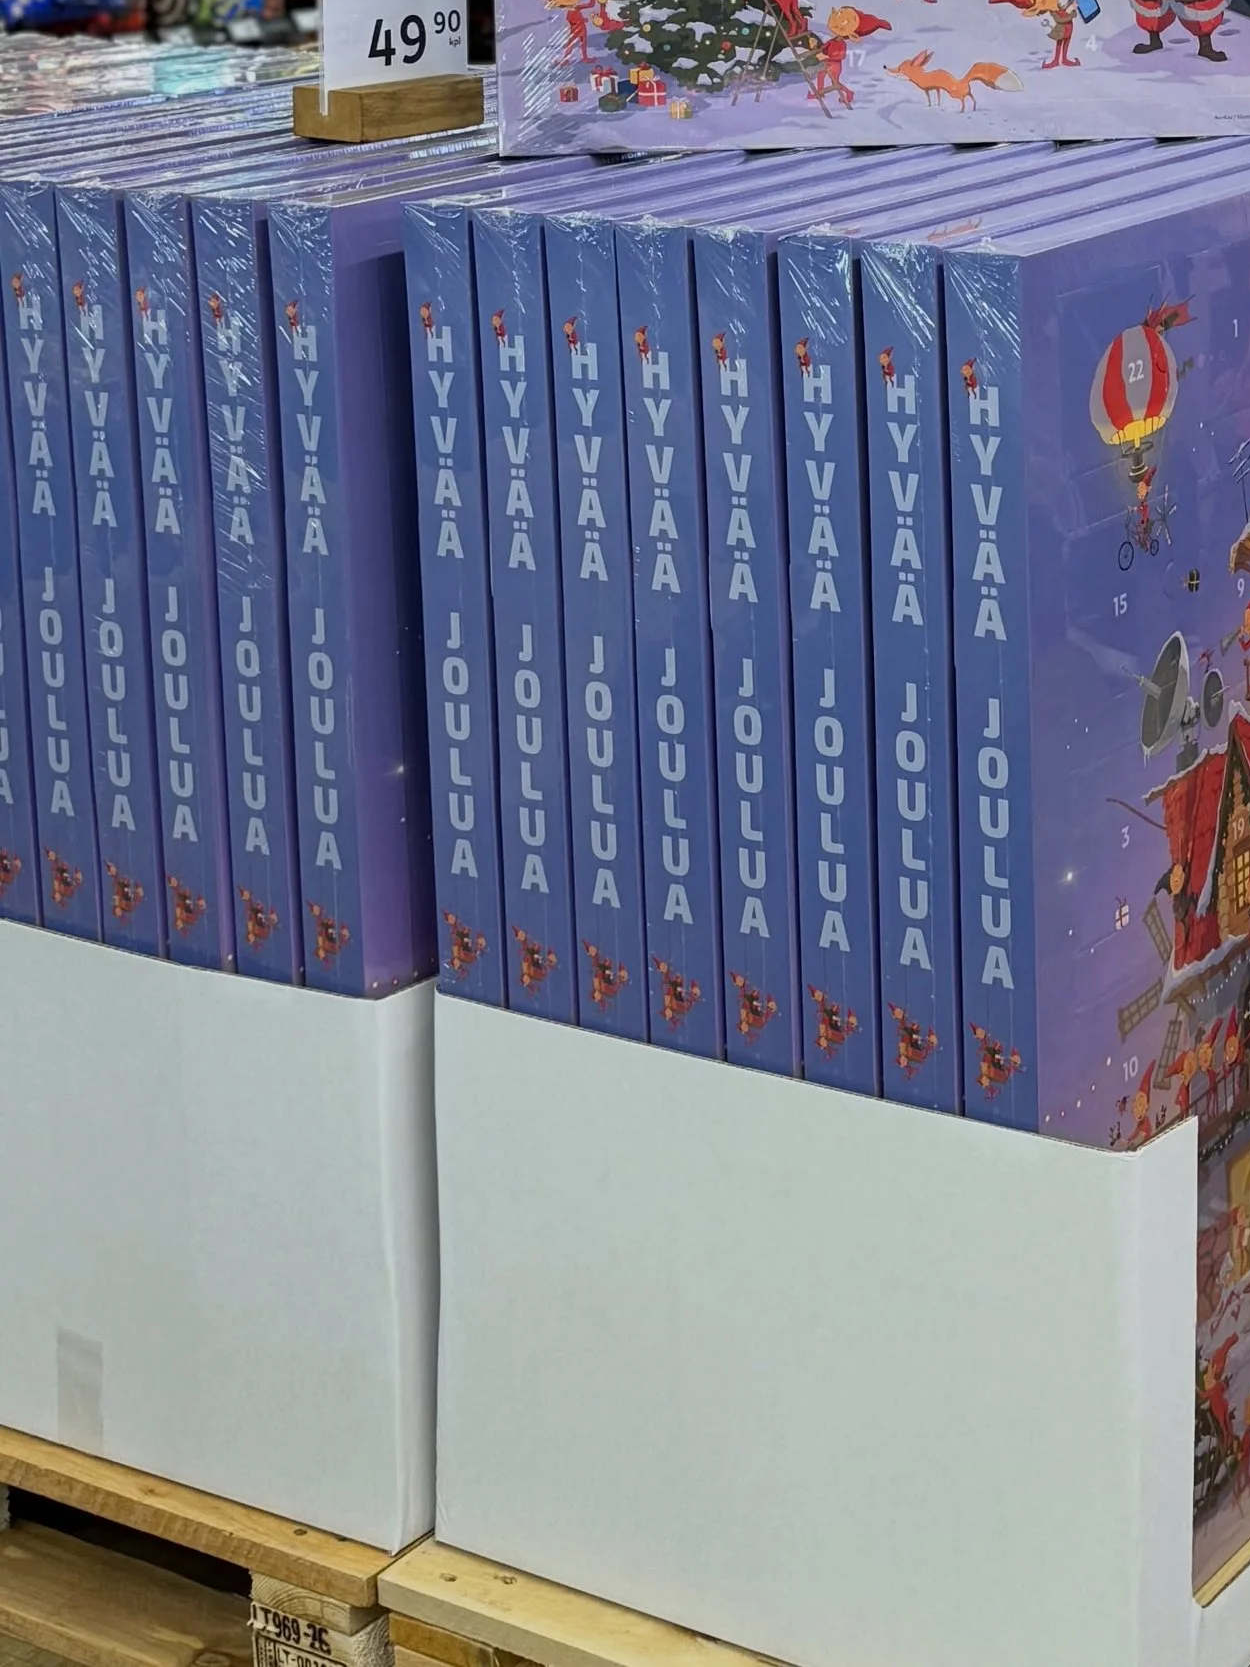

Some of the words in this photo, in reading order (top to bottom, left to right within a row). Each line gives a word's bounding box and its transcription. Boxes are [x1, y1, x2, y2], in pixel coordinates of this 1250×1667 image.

[368, 14, 427, 67] 49
[433, 9, 461, 34] 90
[449, 35, 461, 47] kpl
[845, 50, 866, 67] 17
[1084, 34, 1098, 52] 4
[293, 325, 329, 555] HYVÄÄ
[427, 326, 464, 559] HYVÄÄ
[1128, 359, 1144, 383] 22
[1233, 318, 1239, 338] 1
[19, 294, 56, 516] HYVÄÄ
[39, 567, 75, 817] JOULUA
[81, 305, 117, 527] HYVÄÄ
[100, 578, 136, 831] JOULUA
[500, 335, 536, 571] HYVÄÄ
[571, 342, 608, 582] HYVÄÄ
[642, 351, 681, 593] HYVÄÄ
[720, 359, 759, 603] HYVÄÄ
[803, 365, 841, 612] HYVÄÄ
[886, 374, 924, 626] HYVÄÄ
[969, 386, 1007, 641] HYVÄÄ
[143, 310, 181, 534] HYVÄÄ
[162, 587, 198, 842] JOULUA
[217, 317, 254, 545] HYVÄÄ
[236, 596, 270, 856] JOULUA
[1113, 593, 1128, 616] 15
[1237, 579, 1245, 598] 9
[308, 608, 342, 870] JOULUA
[443, 612, 478, 878] JOULUA
[515, 624, 549, 894] JOULUA
[585, 636, 621, 908] JOULUA
[656, 647, 693, 924] JOULUA
[733, 658, 770, 938] JOULUA
[814, 668, 850, 952] JOULUA
[896, 682, 932, 970] JOULUA
[977, 698, 1014, 989] JOULUA
[1121, 826, 1130, 847] 3
[1233, 817, 1245, 840] 19
[1123, 1056, 1139, 1081] 10
